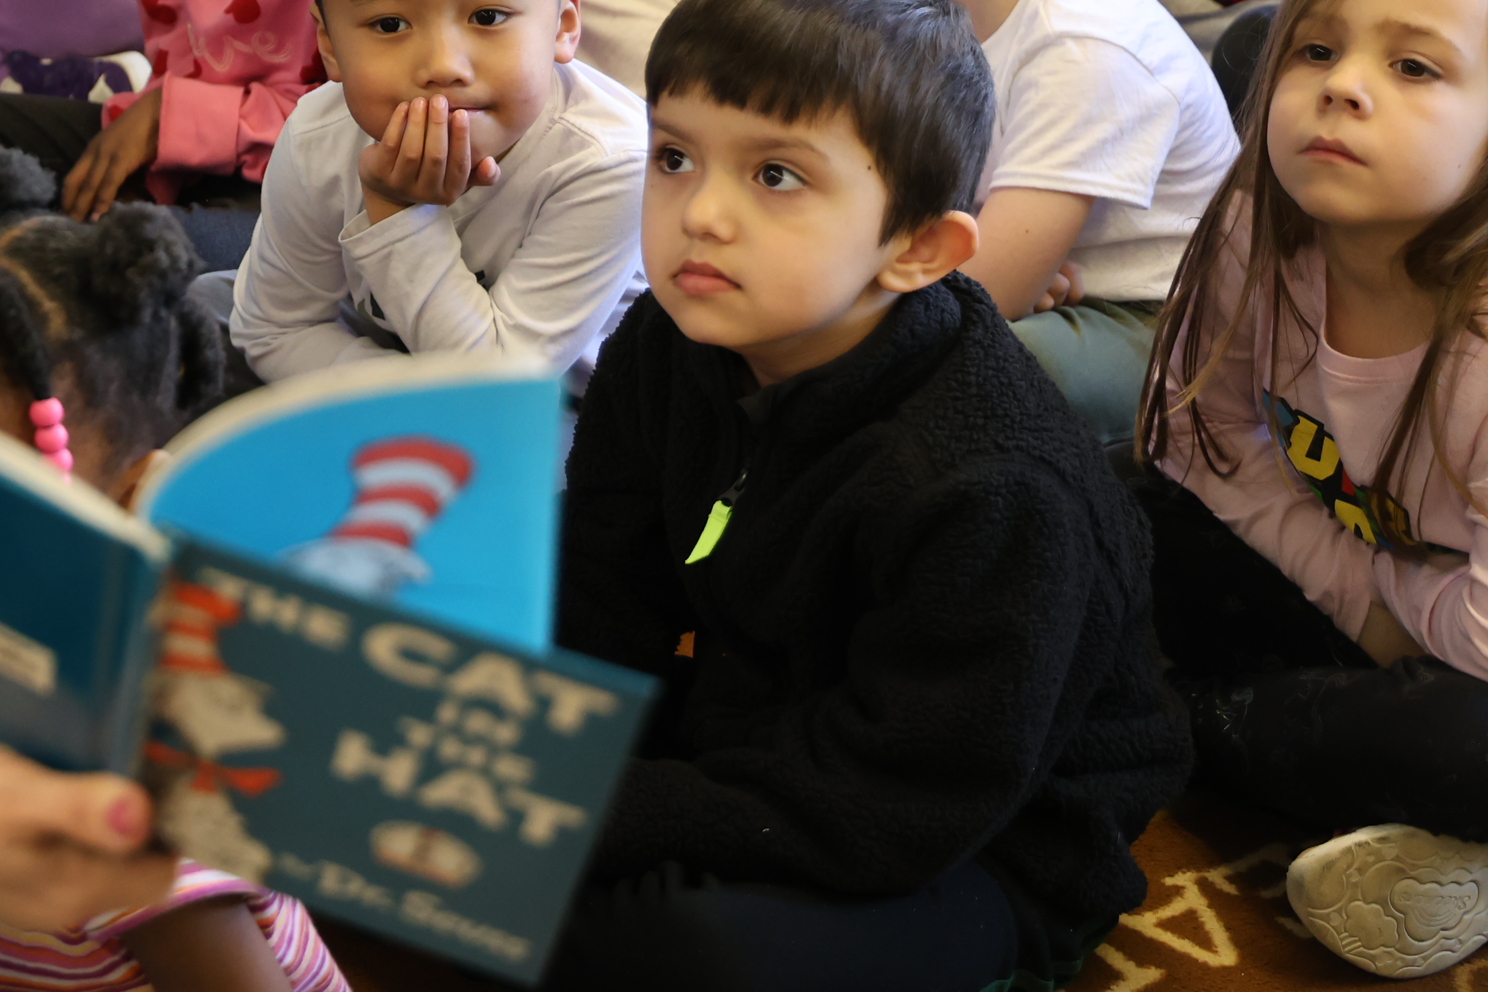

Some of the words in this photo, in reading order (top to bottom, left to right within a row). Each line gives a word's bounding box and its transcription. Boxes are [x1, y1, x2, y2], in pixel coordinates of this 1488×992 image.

[201, 566, 351, 650] THE
[362, 621, 619, 735] CAT
[330, 728, 587, 847] HAT
